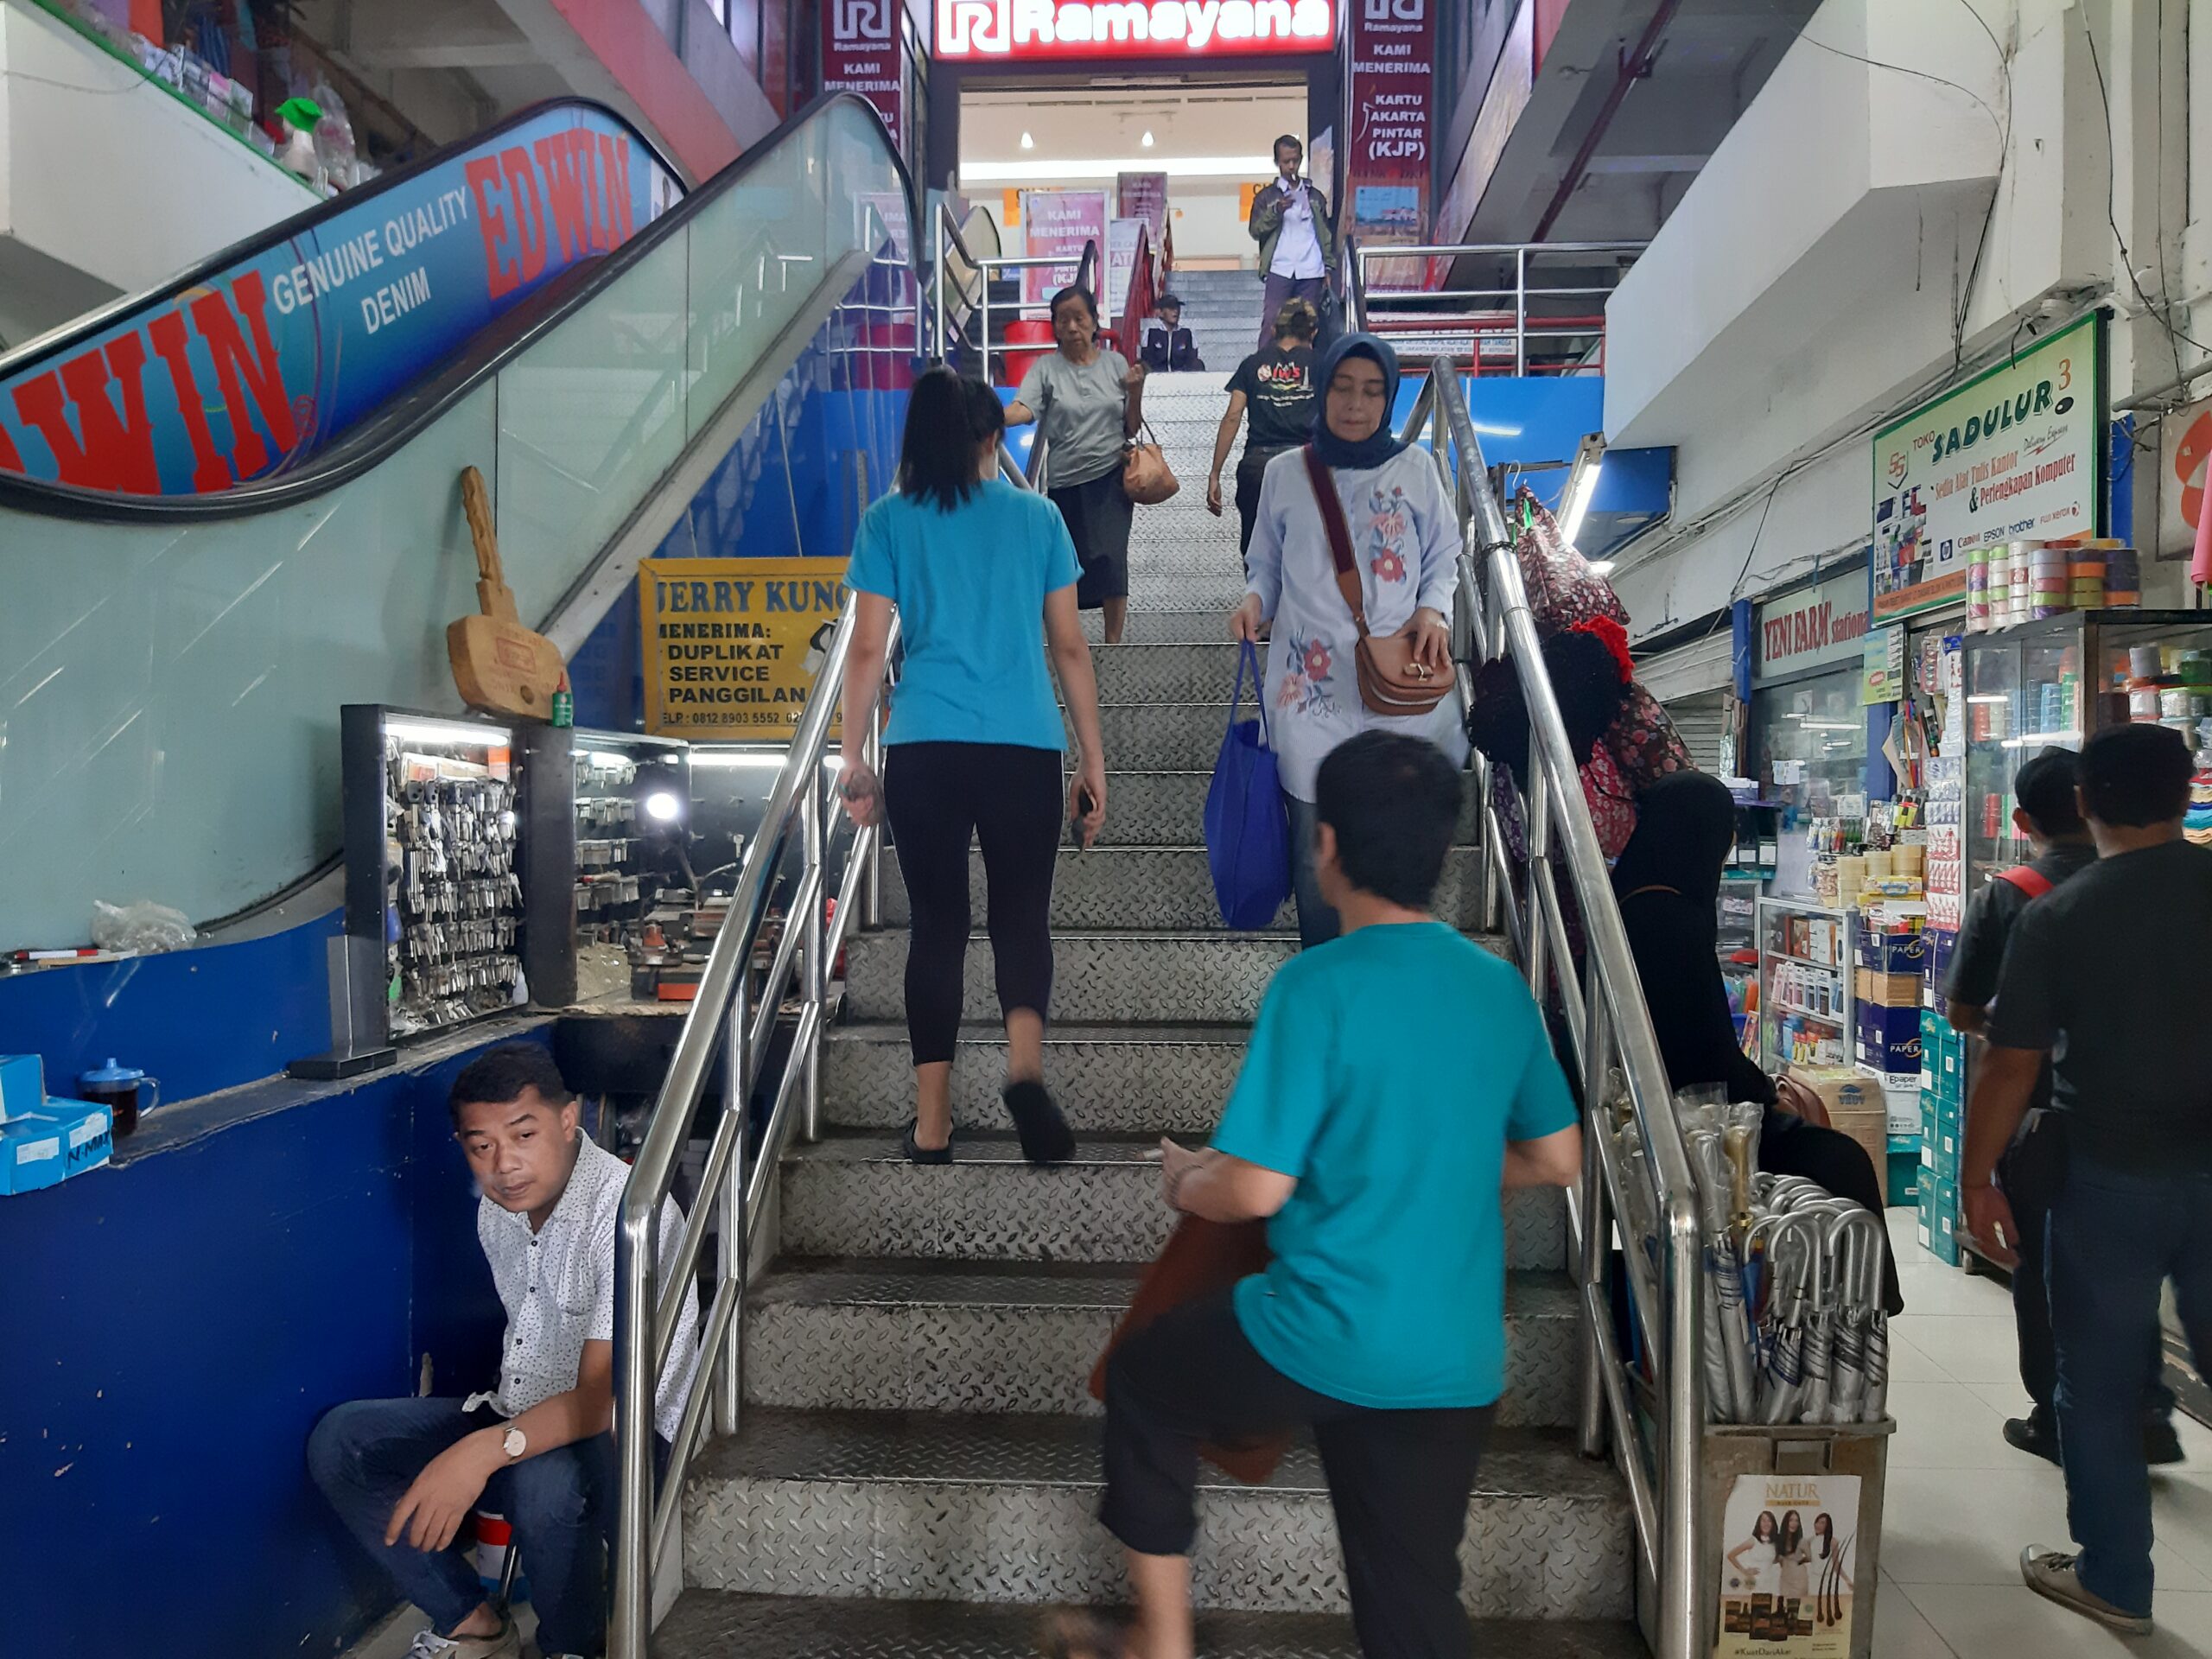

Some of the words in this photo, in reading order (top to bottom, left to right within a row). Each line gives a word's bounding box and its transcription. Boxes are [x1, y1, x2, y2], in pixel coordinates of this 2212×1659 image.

[1013, 0, 1331, 48] Ramayana
[1364, 22, 1423, 33] Ramayana
[1373, 44, 1411, 56] KAMI
[843, 63, 880, 75] KAMI
[1352, 61, 1431, 74] MENERIMA
[824, 80, 900, 92] MENERIMA
[1375, 94, 1422, 105] KARTU
[1372, 128, 1422, 139] PINTAR
[1369, 142, 1425, 161] (KJP)
[465, 129, 632, 299] EDWIN
[1047, 210, 1081, 220] KAMI
[1030, 226, 1100, 238] MENERIMA
[273, 229, 382, 315] GENUINE
[385, 186, 468, 257] QUALITY
[360, 269, 432, 334] DENIM
[1913, 430, 1935, 451] TOKO
[1931, 379, 2054, 467] SADULUR
[2058, 358, 2071, 391] 3
[1991, 450, 2018, 478] Kantor
[1969, 486, 1979, 513] &
[1980, 471, 2033, 508] Perlengkapan
[2035, 453, 2075, 487] Komputer
[1957, 533, 1980, 548] Canon
[1983, 526, 2005, 543] EPSON
[2008, 518, 2035, 536] brother
[1764, 614, 1792, 662] YENI
[668, 645, 784, 660] DUPLIKAT
[670, 666, 769, 682] SERVICE
[669, 687, 806, 703] PANGGILAN
[693, 712, 718, 723] 0812
[722, 712, 748, 723] 8903
[753, 712, 779, 723] 5552
[1890, 1045, 1919, 1053] PAPER
[1765, 1483, 1820, 1499] NATUR
